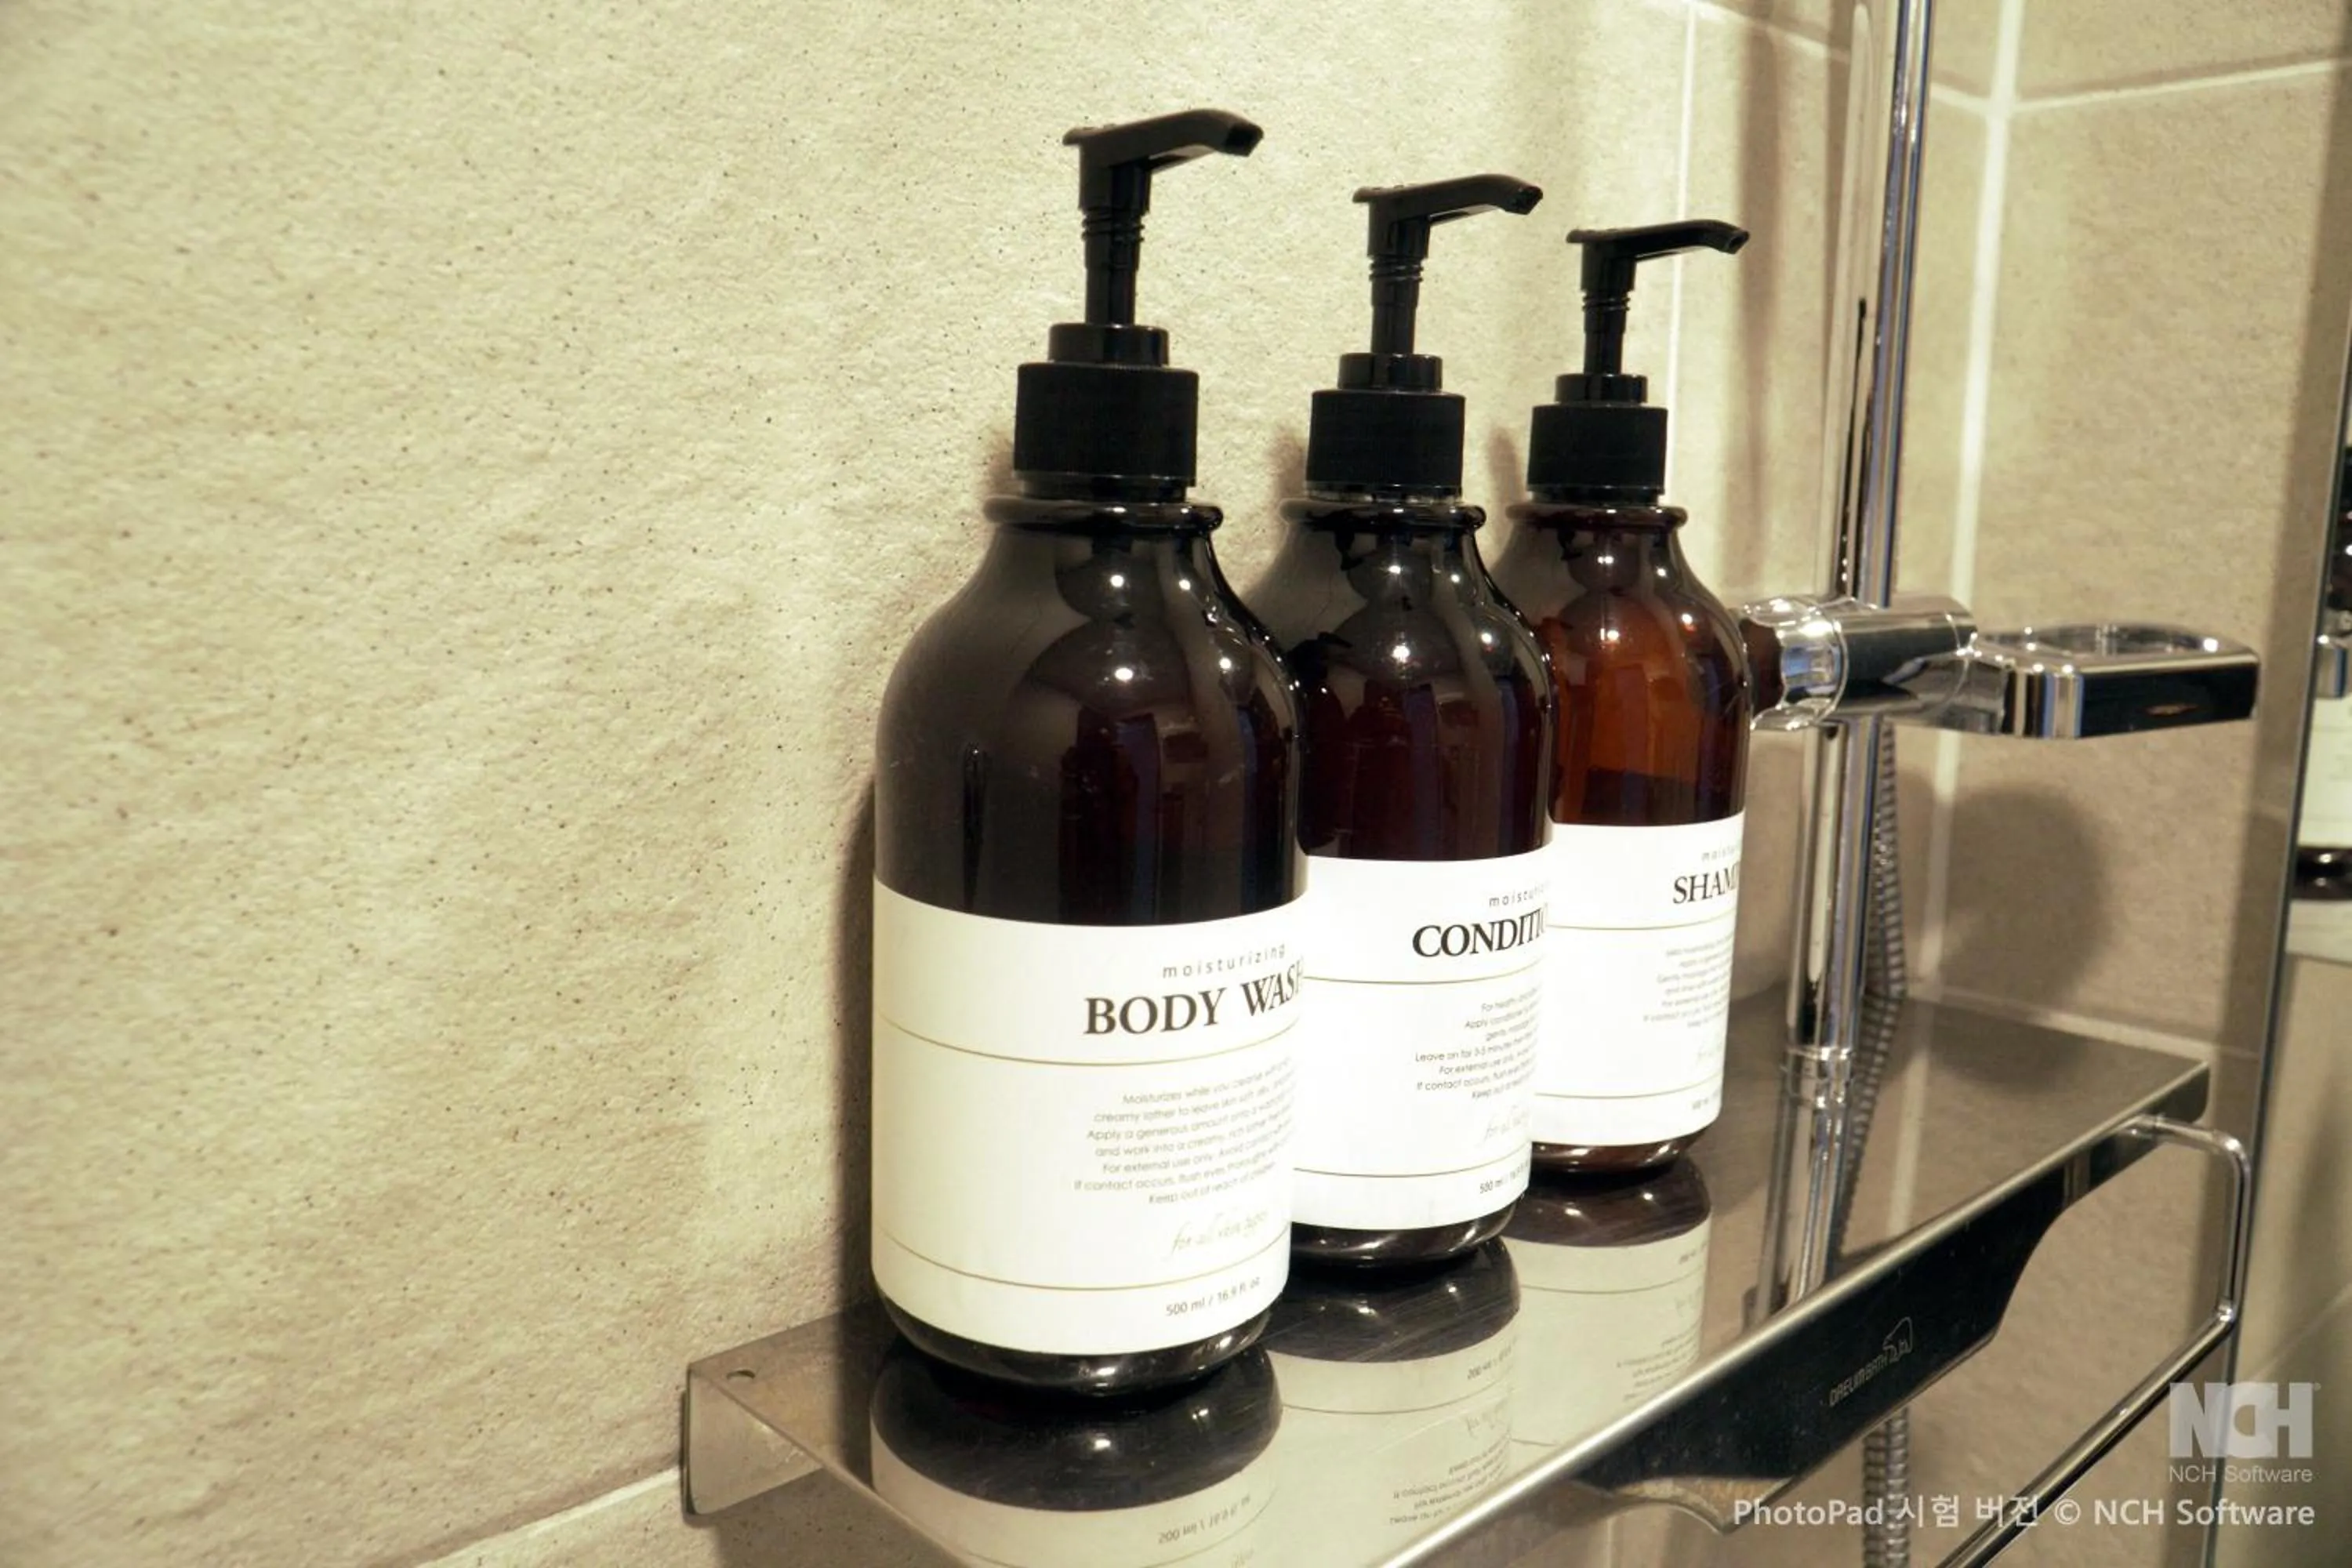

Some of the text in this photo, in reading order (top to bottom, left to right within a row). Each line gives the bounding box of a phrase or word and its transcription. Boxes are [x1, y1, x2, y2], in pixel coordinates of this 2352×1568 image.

[1162, 943, 1286, 979] moisturizing
[1083, 987, 1228, 1036] BODY
[1415, 1051, 1445, 1062] Leave
[1425, 1078, 1461, 1091] contact
[1093, 1111, 1141, 1124] creamy
[1178, 1105, 1190, 1116] to
[1087, 1129, 1121, 1141] Apply
[1124, 1130, 1134, 1140] a
[1136, 1123, 1189, 1141] generous
[1191, 1114, 1229, 1132] amount
[1095, 1147, 1120, 1157] and
[1123, 1145, 1150, 1157] work
[1152, 1142, 1174, 1154] into
[1177, 1142, 1185, 1152] a
[1103, 1163, 1121, 1174] For
[1123, 1158, 1170, 1173] external
[1074, 1178, 1082, 1190] If
[1083, 1178, 1133, 1192] contact
[1165, 1301, 1188, 1316] 500
[1190, 1297, 1205, 1312] ml
